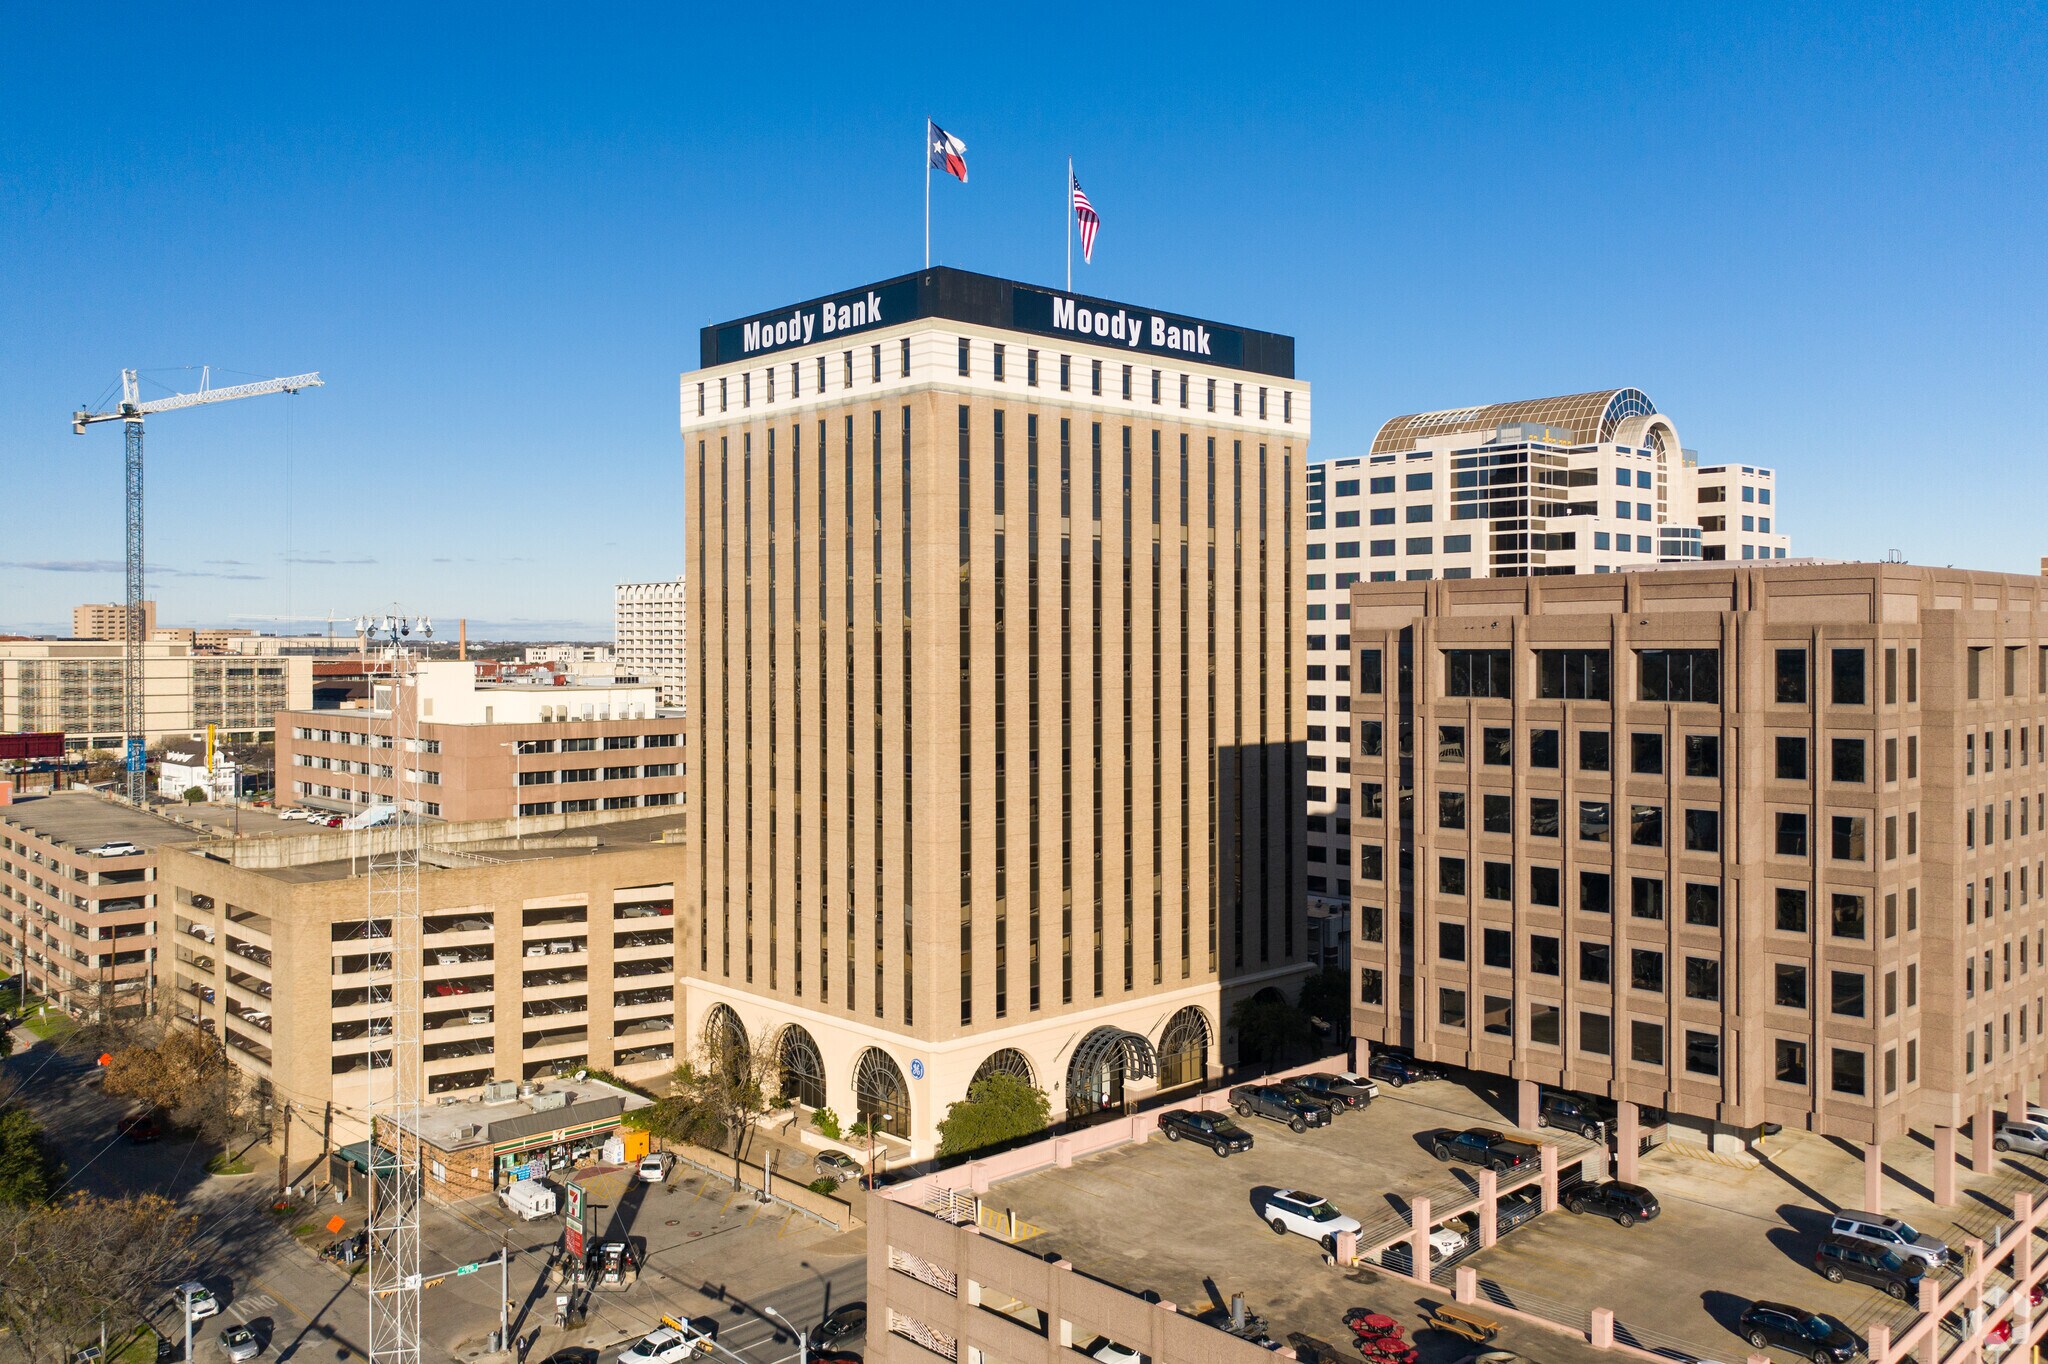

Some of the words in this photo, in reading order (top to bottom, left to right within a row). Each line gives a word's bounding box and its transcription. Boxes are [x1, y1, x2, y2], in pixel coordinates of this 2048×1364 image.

[744, 310, 815, 352] Moody
[823, 291, 882, 334] Bank
[1053, 297, 1142, 347] Moody
[1151, 316, 1211, 355] Bank
[235, 1295, 279, 1315] ONLY
